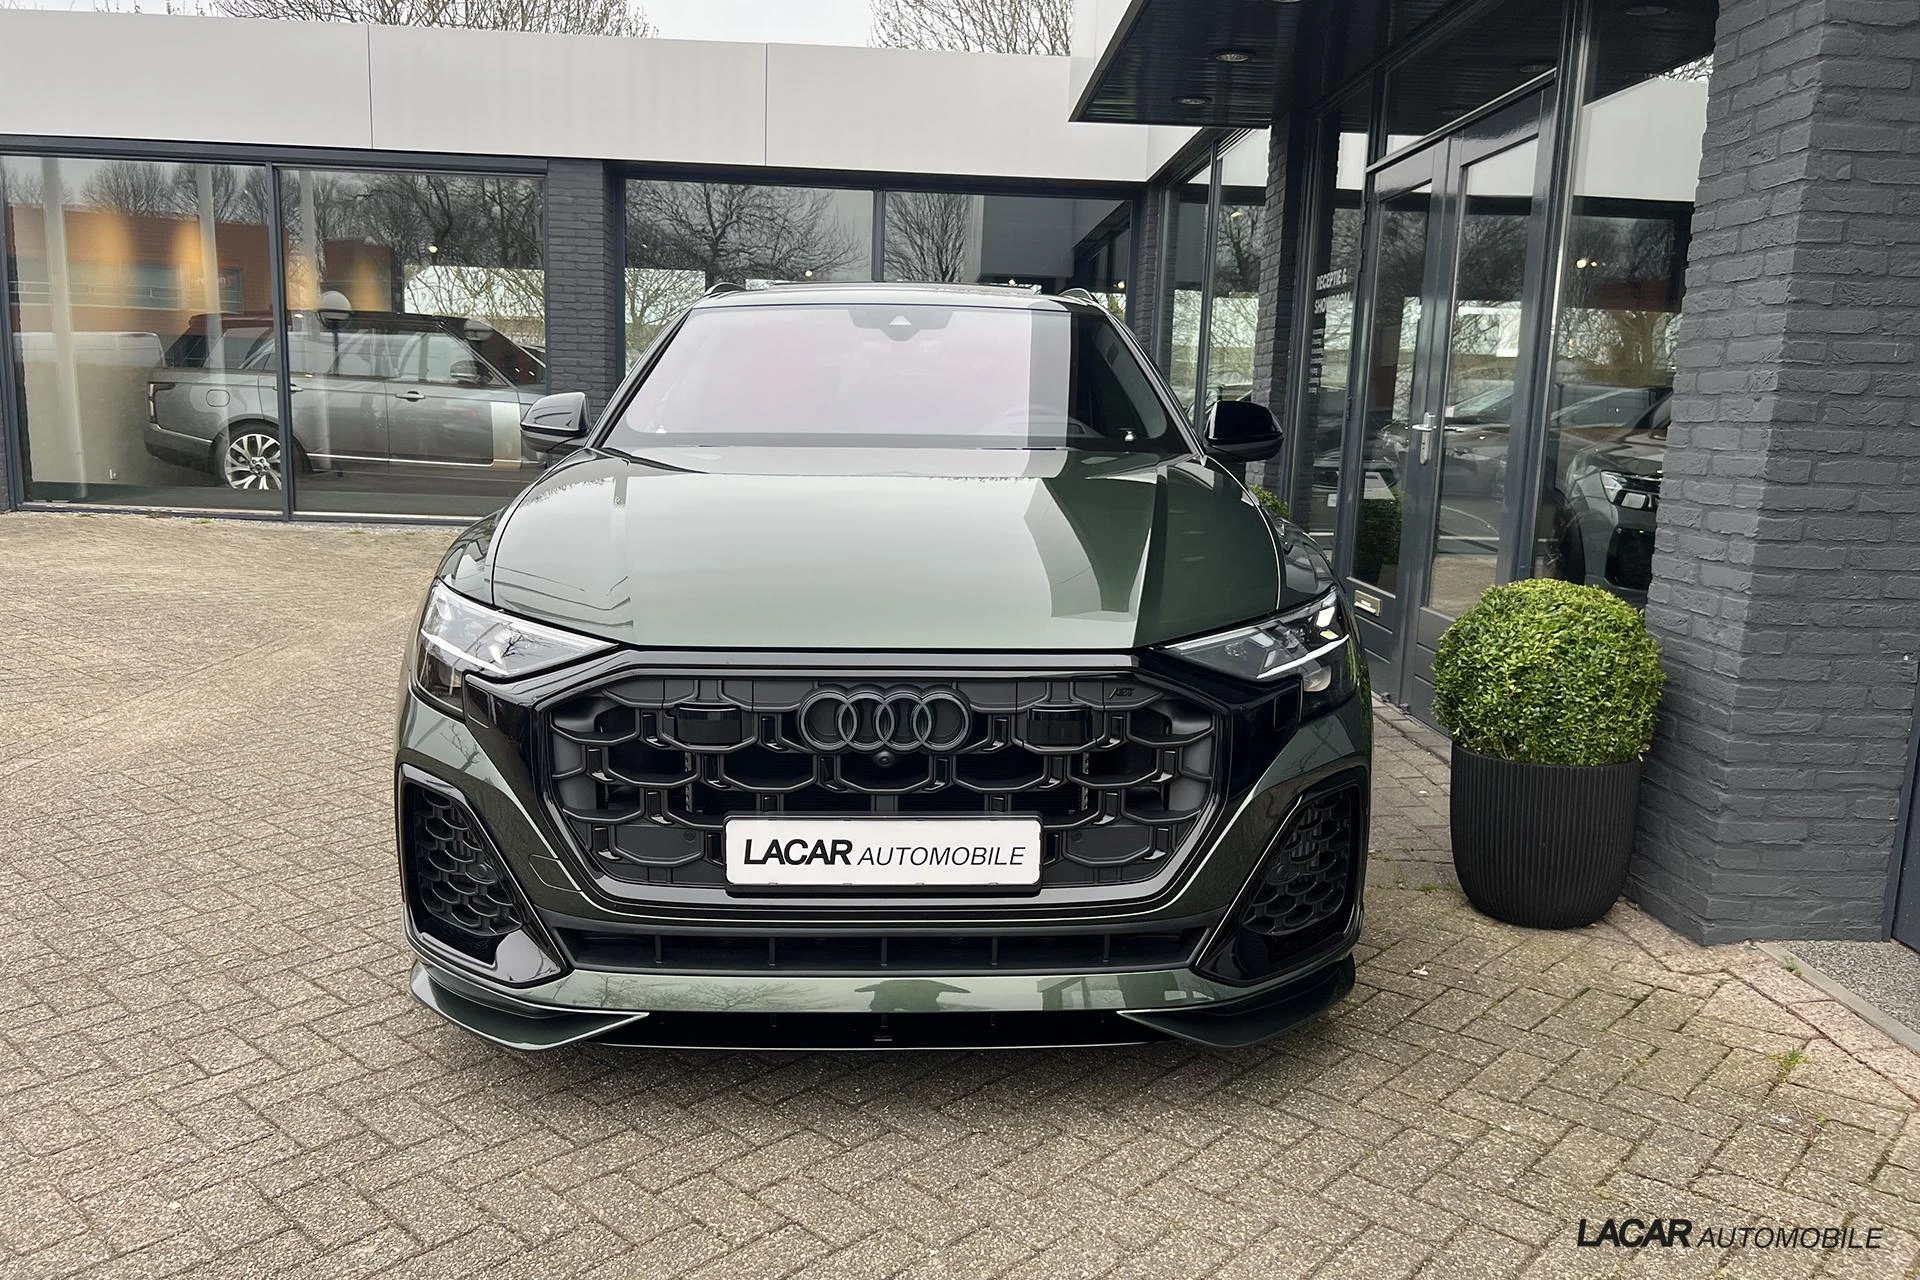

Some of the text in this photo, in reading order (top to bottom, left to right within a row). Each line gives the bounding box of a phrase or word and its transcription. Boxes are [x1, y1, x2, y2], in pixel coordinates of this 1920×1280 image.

[1316, 269, 1342, 291] RECEPTIE
[743, 838, 1026, 866] LACAR AUTOMOBILE
